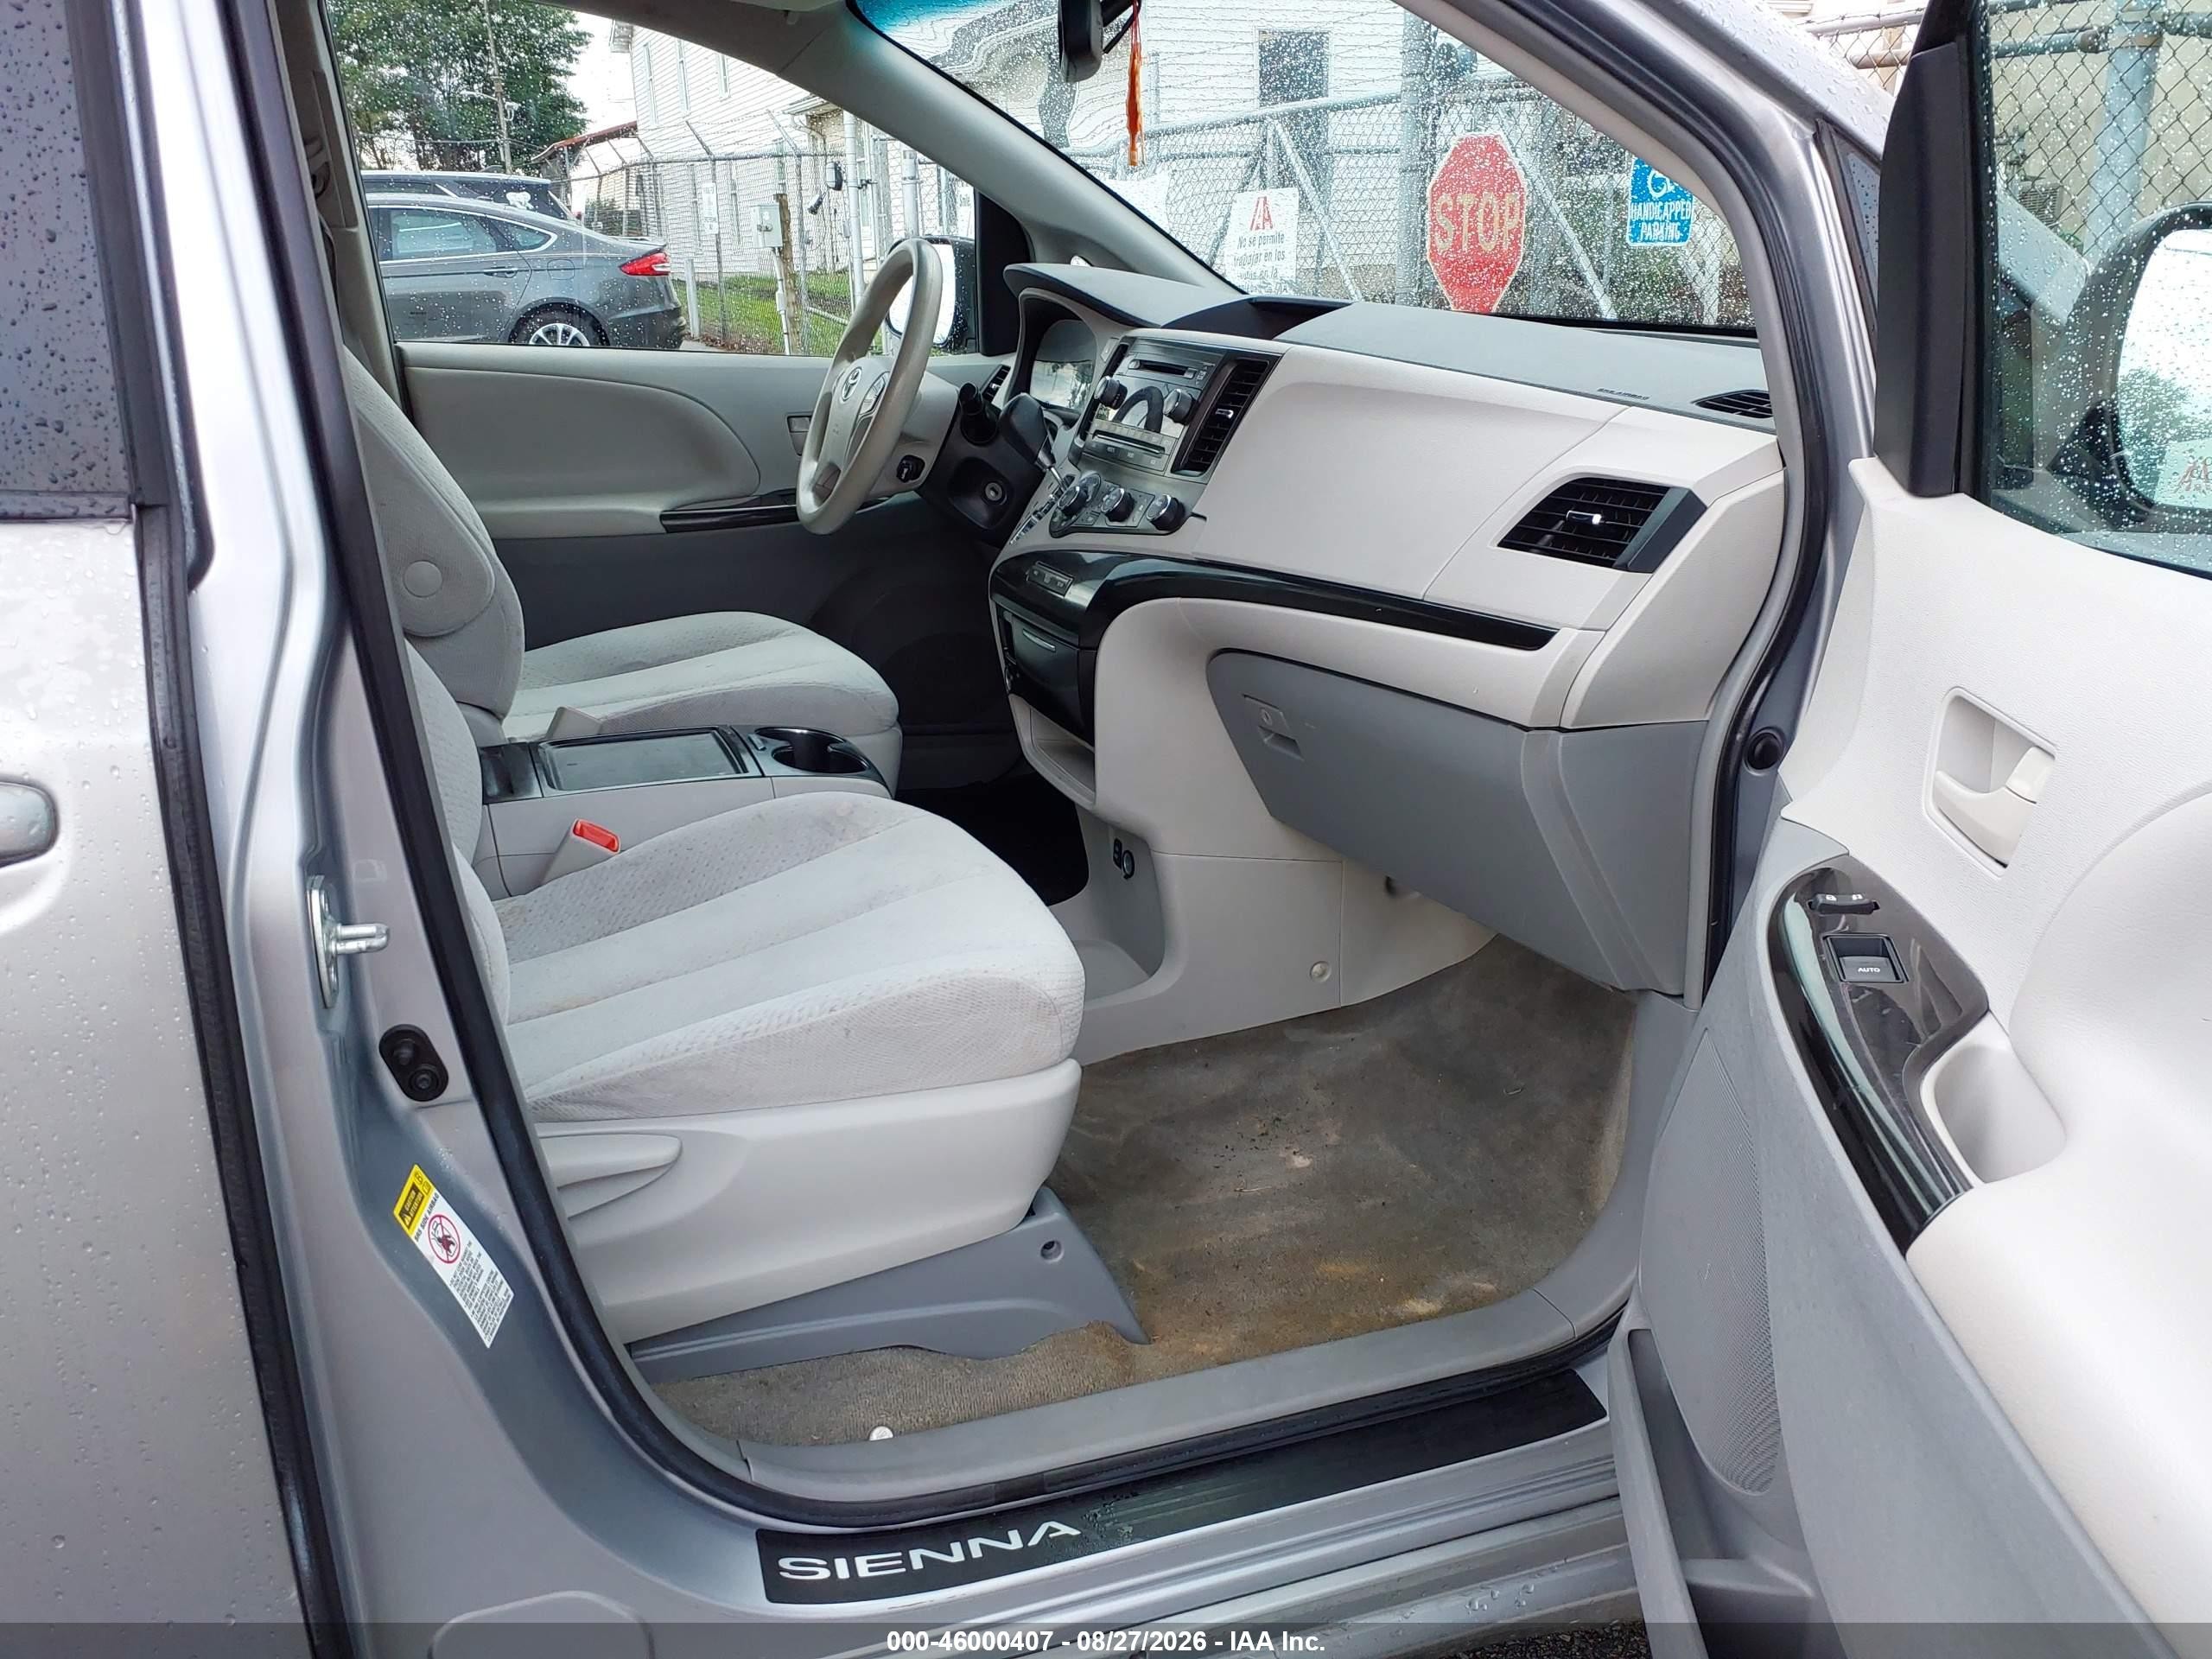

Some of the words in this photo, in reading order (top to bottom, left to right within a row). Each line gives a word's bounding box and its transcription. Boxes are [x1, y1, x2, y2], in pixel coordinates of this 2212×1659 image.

[1630, 200, 1692, 220] HANDICAPPED
[1435, 192, 1520, 253] STOP
[1641, 220, 1681, 241] PARKING
[1237, 234, 1247, 249] No
[1249, 235, 1256, 247] se
[1258, 231, 1285, 248] permite
[1264, 251, 1273, 263] en
[1274, 249, 1286, 261] los
[427, 1192, 439, 1216] AIRBAG
[778, 1521, 1081, 1580] SIENNA
